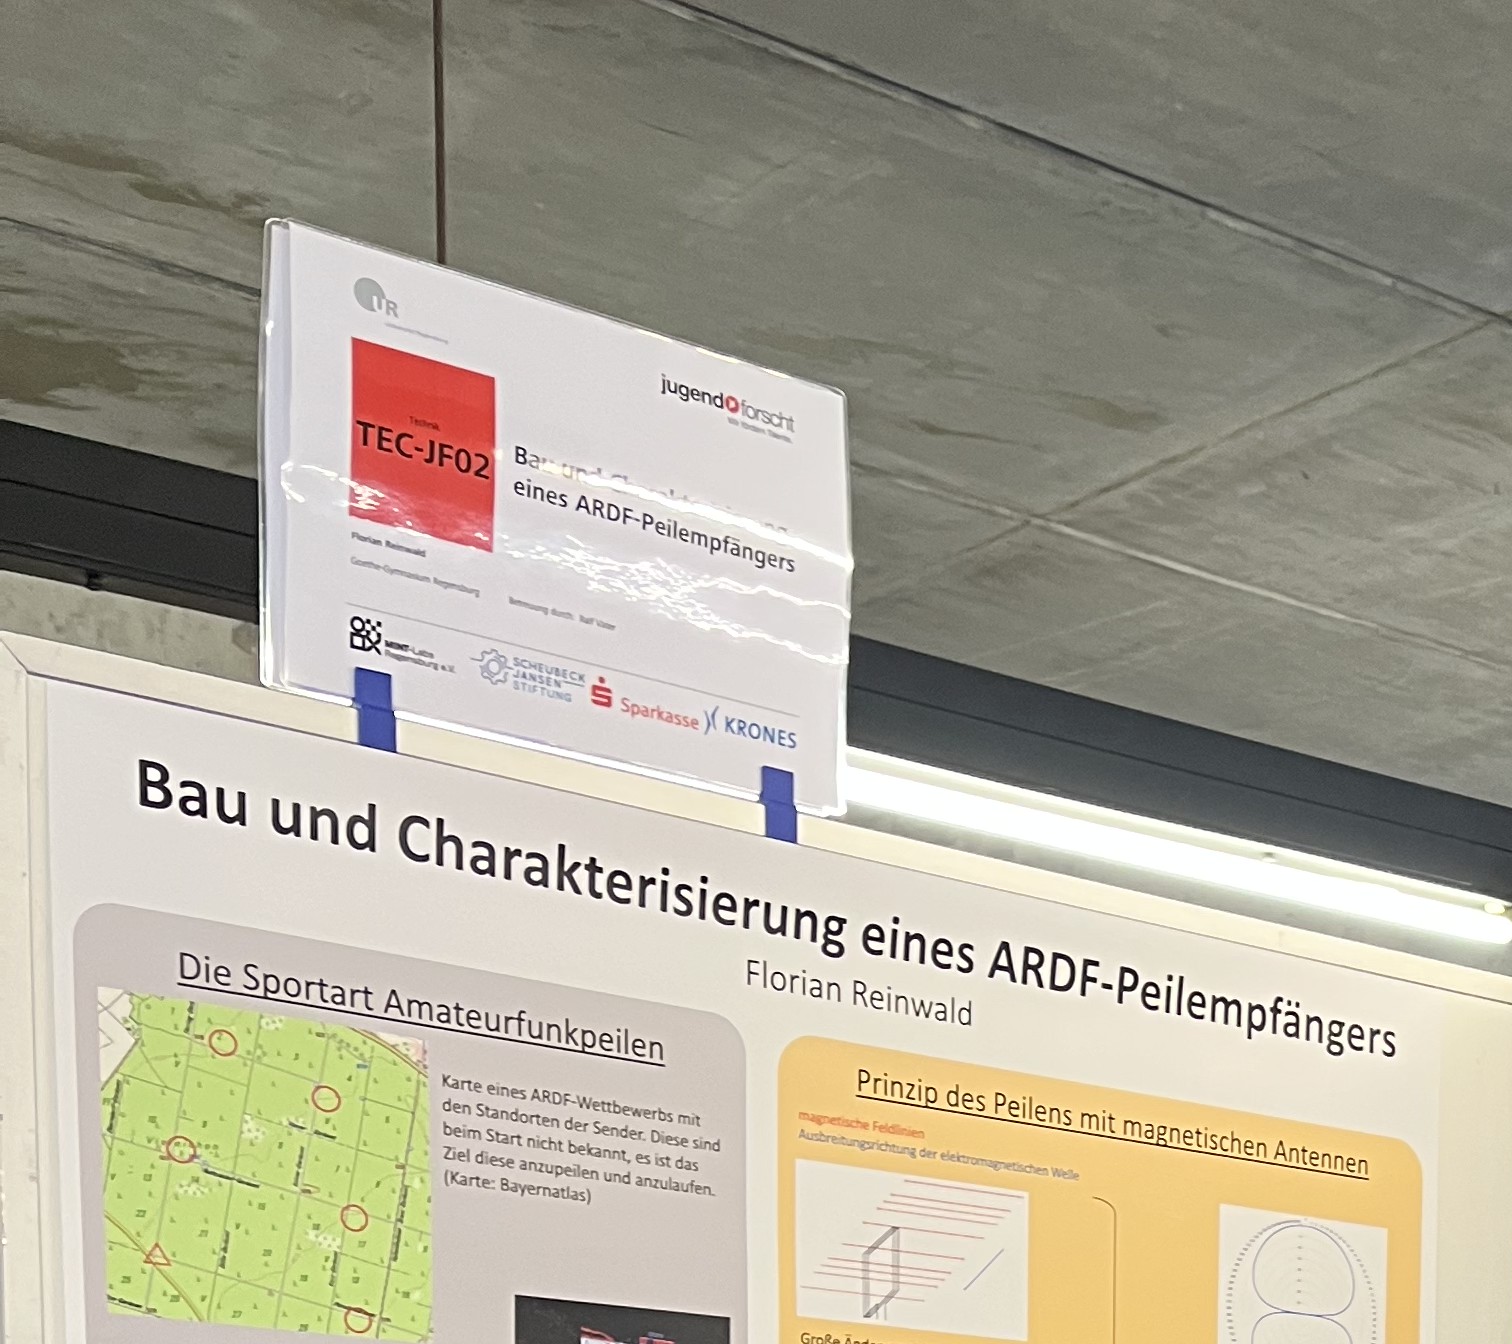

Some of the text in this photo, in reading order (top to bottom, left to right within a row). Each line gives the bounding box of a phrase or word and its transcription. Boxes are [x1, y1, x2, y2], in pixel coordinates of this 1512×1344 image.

[661, 374, 724, 410] jugend
[741, 399, 795, 434] forscht
[356, 420, 490, 480] TEC-JF02
[513, 478, 567, 507] eines
[575, 494, 794, 572] ARDF-Peilempfängers
[512, 670, 562, 689] JANSEN
[513, 657, 586, 684] SCHEUBECK
[513, 681, 573, 703] STIFTUNG
[621, 697, 699, 732] Sparkasse
[725, 716, 796, 749] KRONES
[138, 758, 1395, 1057] Bau und Charakterisierung eines ARDF-Peilempfängers
[178, 951, 665, 1063] Die Sportart Amateurfunkpeilen
[747, 959, 971, 1026] Florian Reinwald
[441, 1073, 700, 1127] Karte eines ARDF-Wettbewerbs mit
[441, 1097, 720, 1152] den Standorten der Sender. Diese sind
[857, 1070, 1368, 1176] Prinzip des Peilens mit magnetischen Antennen
[442, 1120, 699, 1172] beim Start nicht bekannt, es ist das
[442, 1145, 715, 1196] Ziel diese anzupeilen und anzulaufen.
[443, 1169, 591, 1205] (Karte: Bayernatlas)
